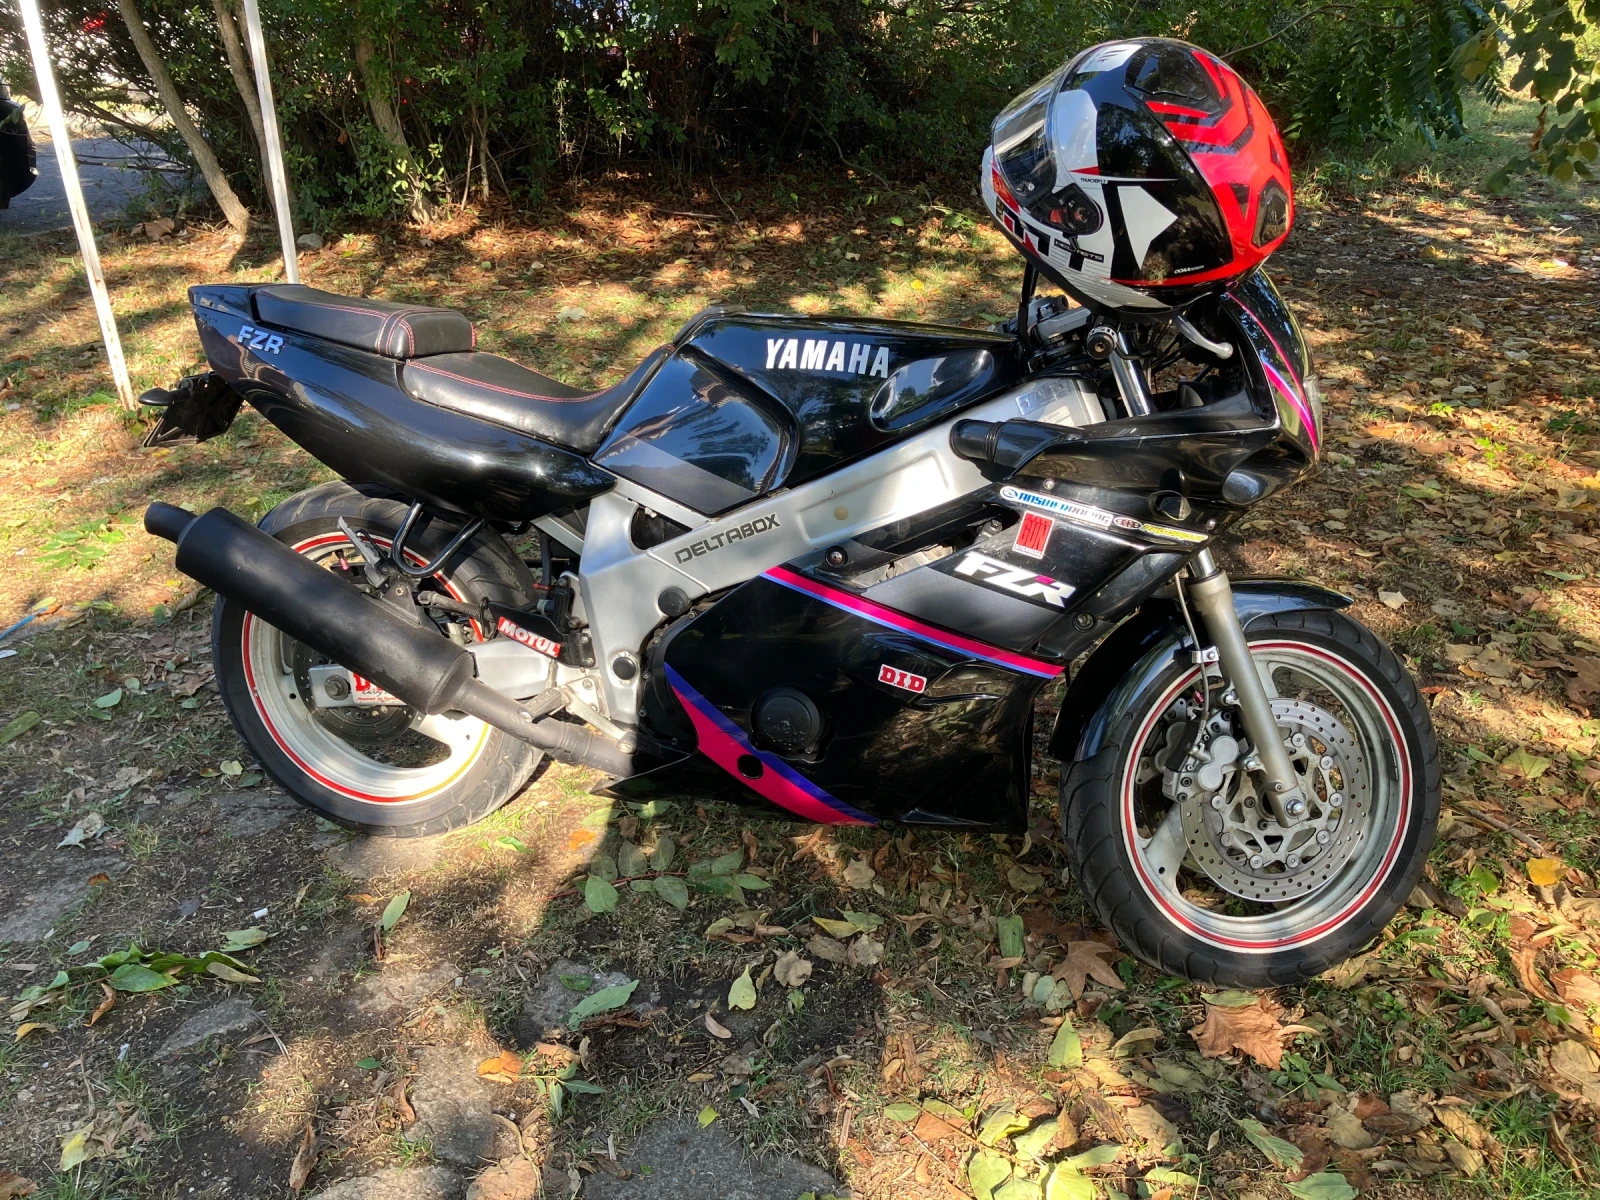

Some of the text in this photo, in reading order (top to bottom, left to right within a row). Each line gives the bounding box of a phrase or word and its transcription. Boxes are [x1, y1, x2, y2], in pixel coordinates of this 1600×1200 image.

[237, 324, 284, 355] FZR
[765, 338, 889, 378] YAMAHA
[674, 512, 781, 565] DELTABOX
[1016, 519, 1052, 552] GUN
[954, 551, 1076, 608] FZR
[500, 619, 559, 656] MOTUL
